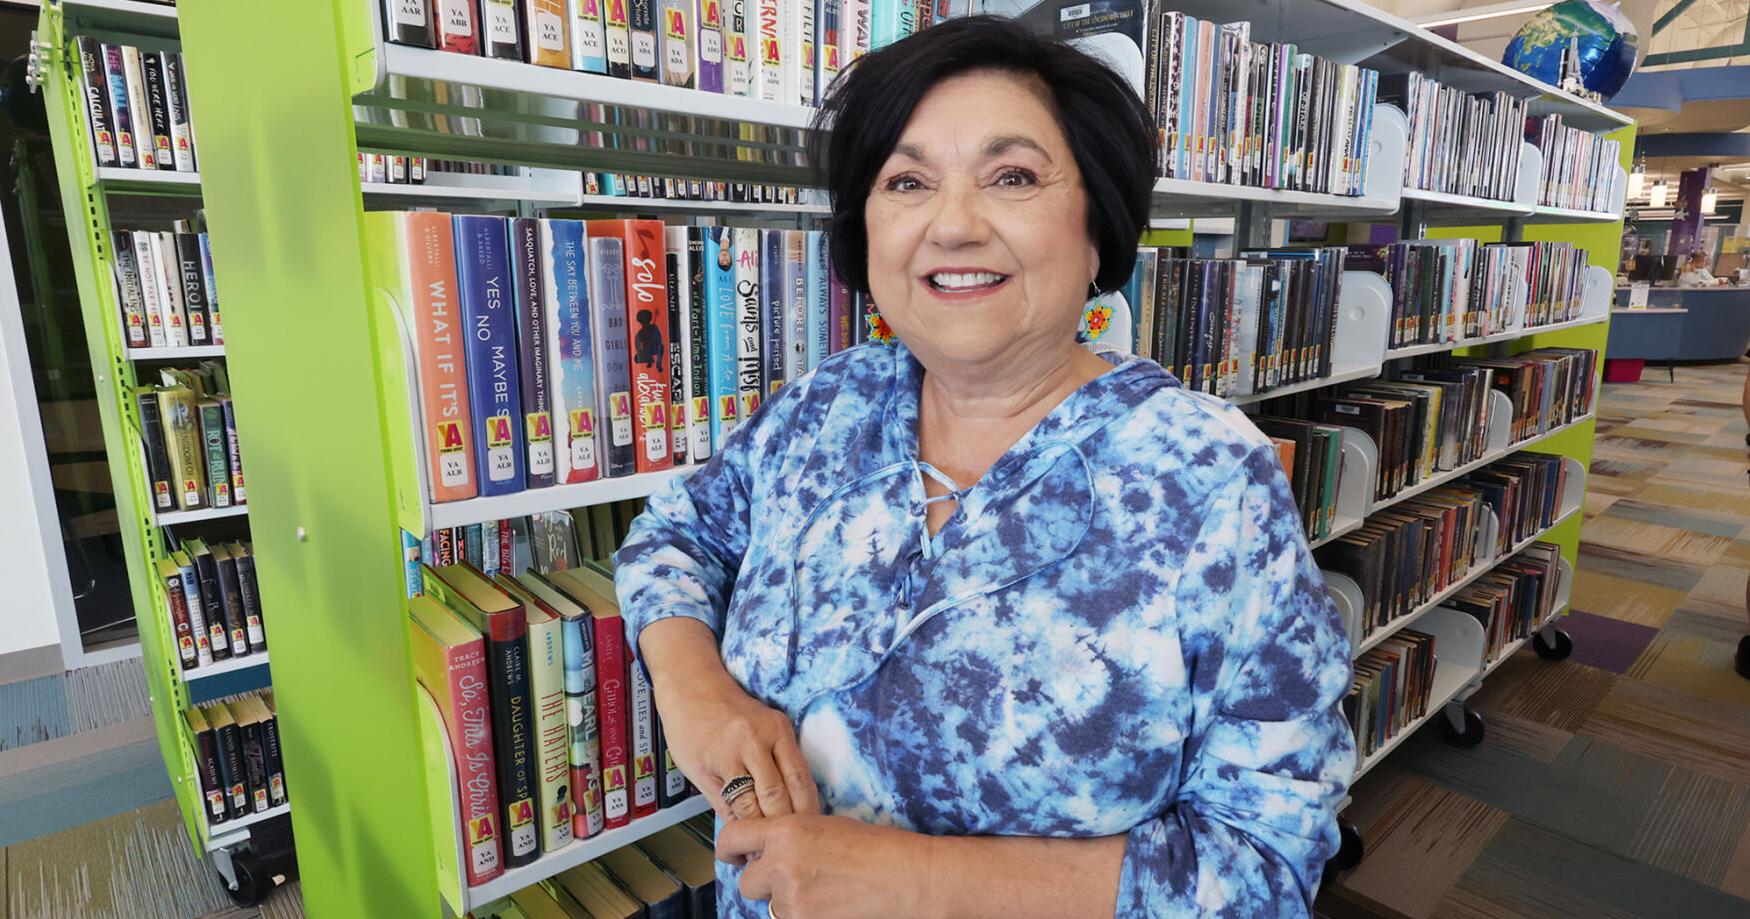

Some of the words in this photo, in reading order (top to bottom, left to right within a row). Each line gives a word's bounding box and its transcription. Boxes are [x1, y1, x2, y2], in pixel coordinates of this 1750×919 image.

[401, 6, 421, 16] AAR
[449, 18, 468, 28] ABB
[451, 9, 464, 18] YA
[495, 15, 507, 24] YA
[494, 24, 511, 33] ACE
[542, 32, 559, 41] ACE
[544, 23, 556, 32] YA
[585, 31, 596, 39] YA
[613, 38, 623, 46] YA
[640, 39, 649, 48] YA
[525, 227, 536, 277] SASQUATCH,
[564, 240, 576, 258] THE
[566, 260, 577, 276] SKY
[631, 256, 665, 303] solo
[486, 276, 501, 310] YES
[529, 277, 538, 300] LOVE,
[568, 277, 580, 319] BETWEEN
[818, 277, 829, 315] ALWAYS
[428, 280, 452, 345] WHAT
[531, 301, 540, 318] AND
[736, 279, 760, 334] Saints
[771, 300, 783, 336] picture
[795, 277, 805, 335] BEFORE
[476, 315, 492, 342] NO
[532, 319, 541, 346] OTHER
[570, 319, 581, 337] YOU
[572, 337, 582, 357] AND
[771, 338, 784, 372] perfect
[436, 354, 454, 374] IF
[491, 346, 509, 404] MAYBE
[533, 346, 545, 386] IMAGINARY
[738, 357, 761, 391] Misf
[693, 364, 701, 399] Indian
[439, 383, 460, 417] IT'S
[536, 387, 546, 412] THING
[437, 423, 463, 448] YA
[488, 418, 511, 442] YA
[438, 529, 453, 568] FACING
[453, 651, 481, 663] TRACY
[459, 675, 484, 706] So,
[541, 688, 564, 721] THE
[637, 698, 648, 723] LIES
[582, 694, 597, 741] EARL
[510, 695, 527, 766] DAUGHTER
[638, 724, 648, 741] and
[543, 723, 569, 783] HATERS
[517, 770, 528, 782] OF
[520, 833, 530, 842] YA
[480, 849, 491, 858] YA
